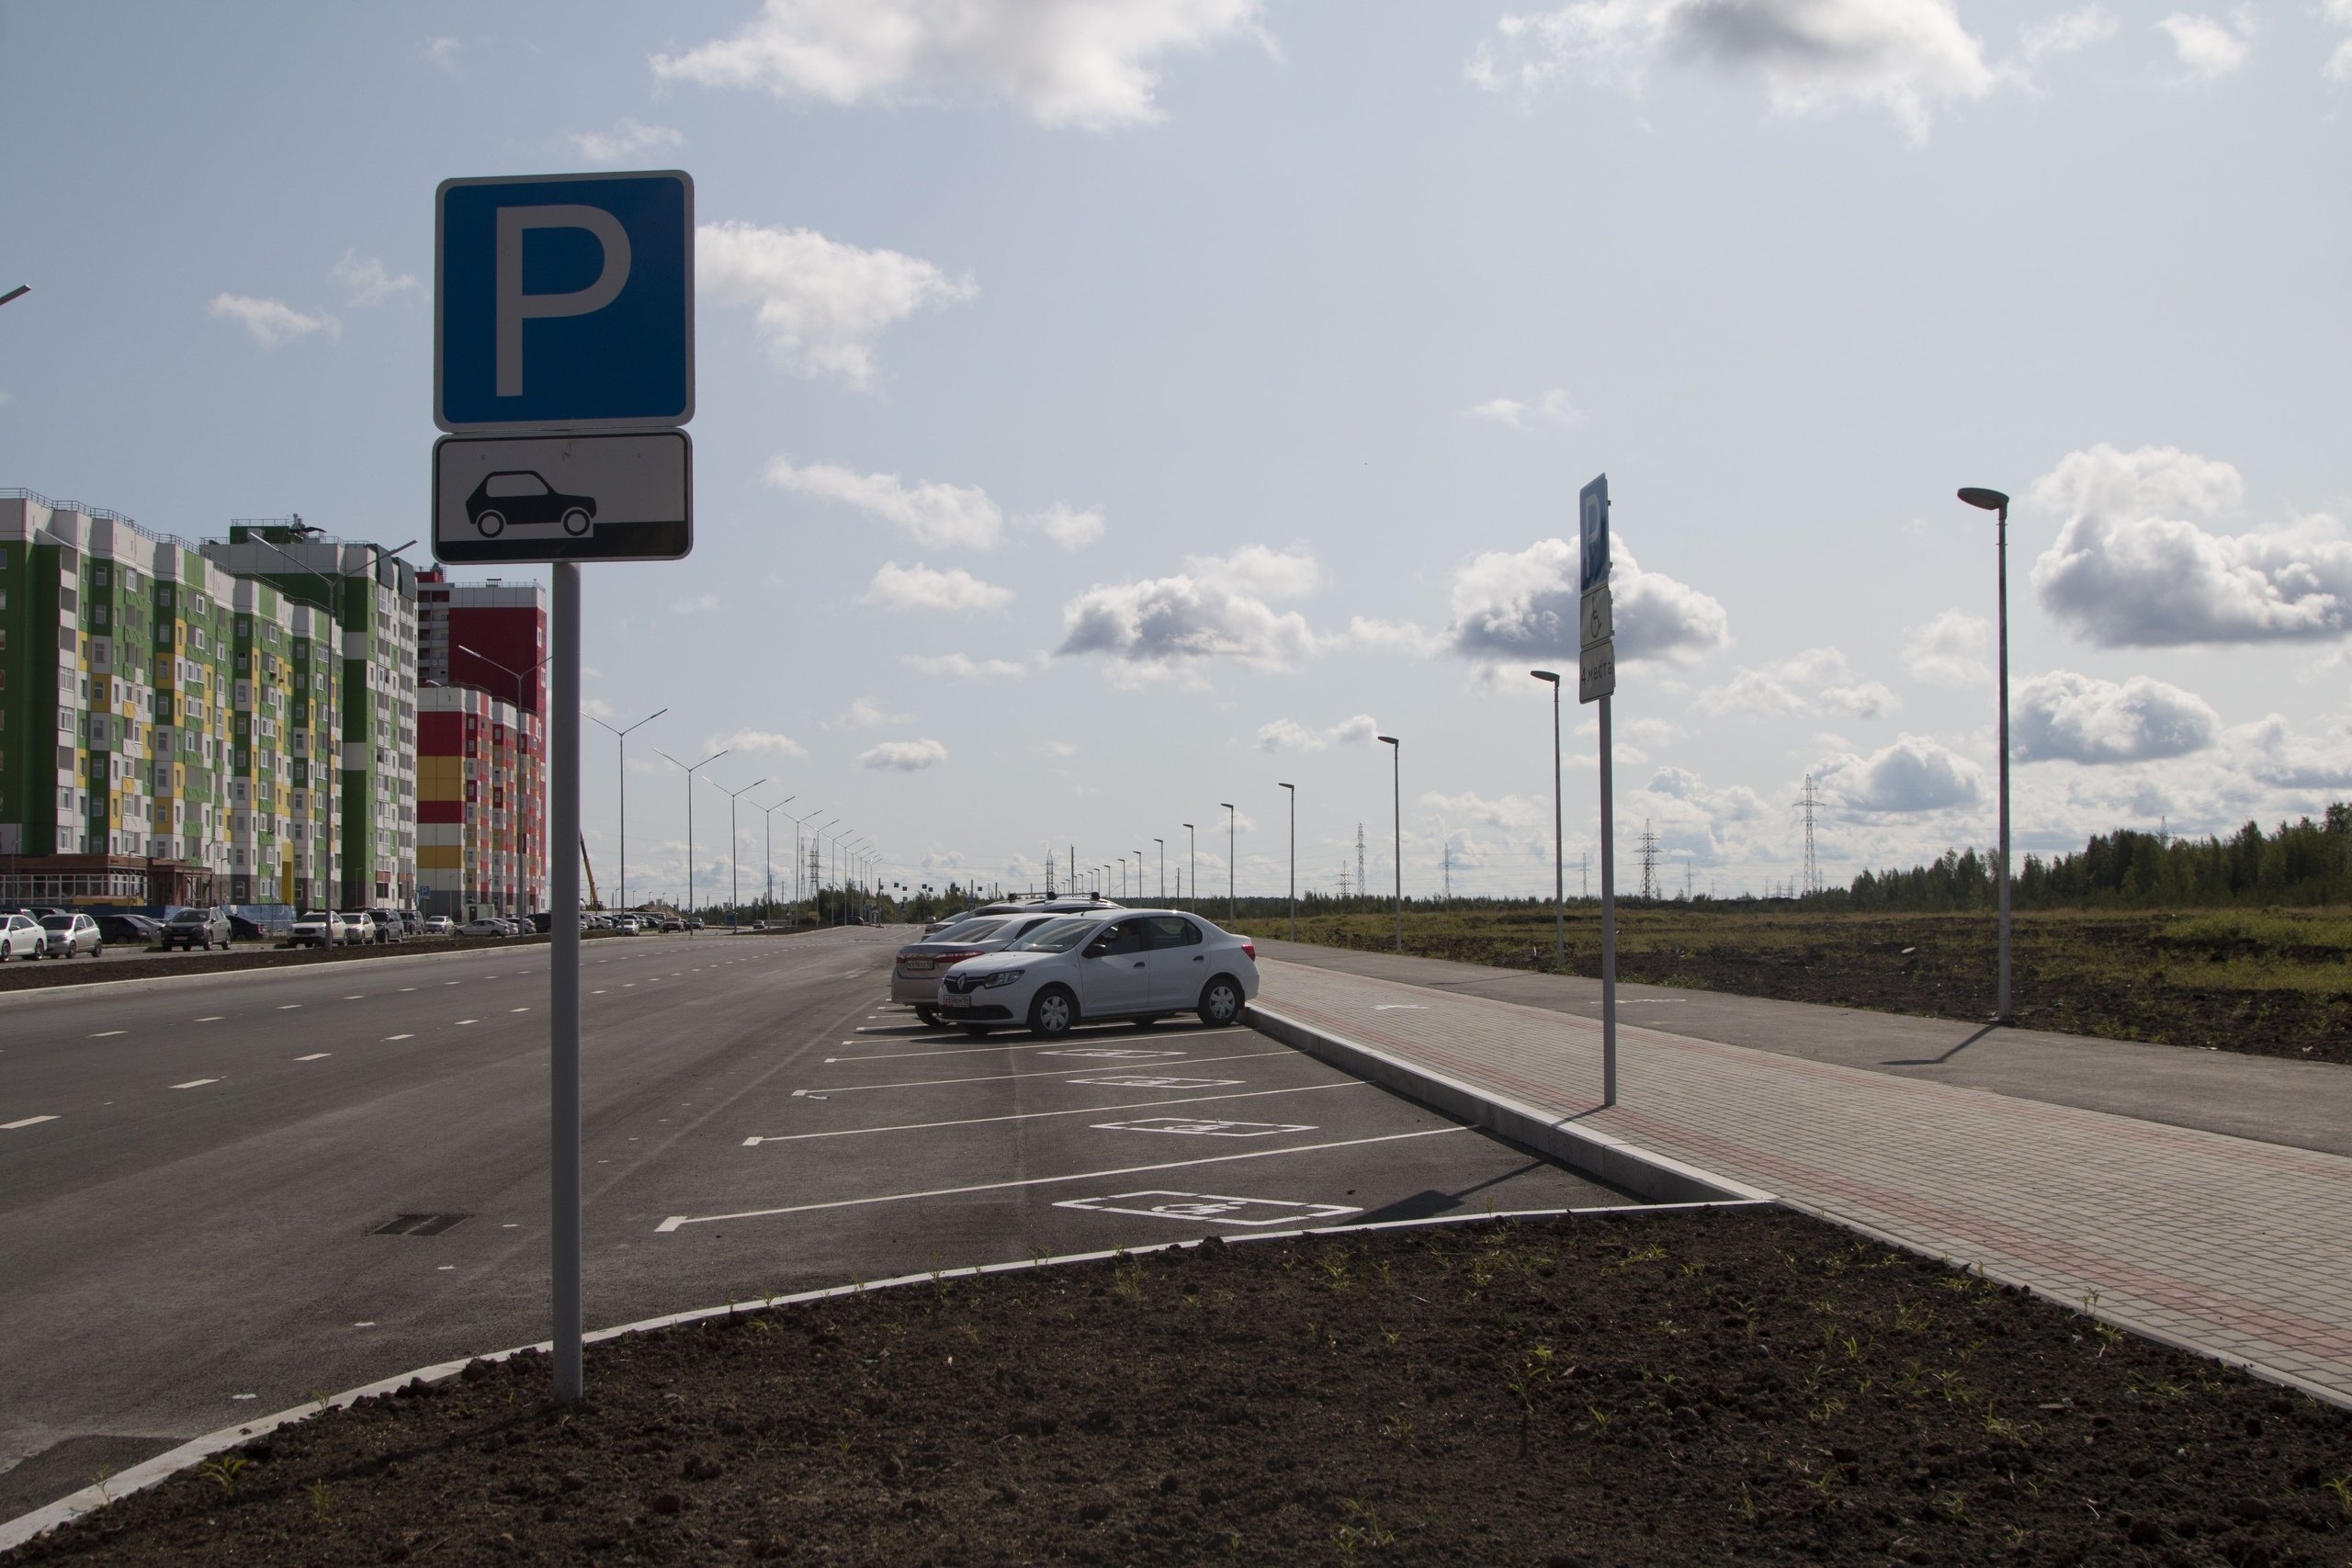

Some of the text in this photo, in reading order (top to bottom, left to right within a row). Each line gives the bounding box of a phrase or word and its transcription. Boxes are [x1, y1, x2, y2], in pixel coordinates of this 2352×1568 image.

[496, 204, 631, 397] P
[1586, 493, 1601, 579] P
[1580, 661, 1612, 683] 4 места
